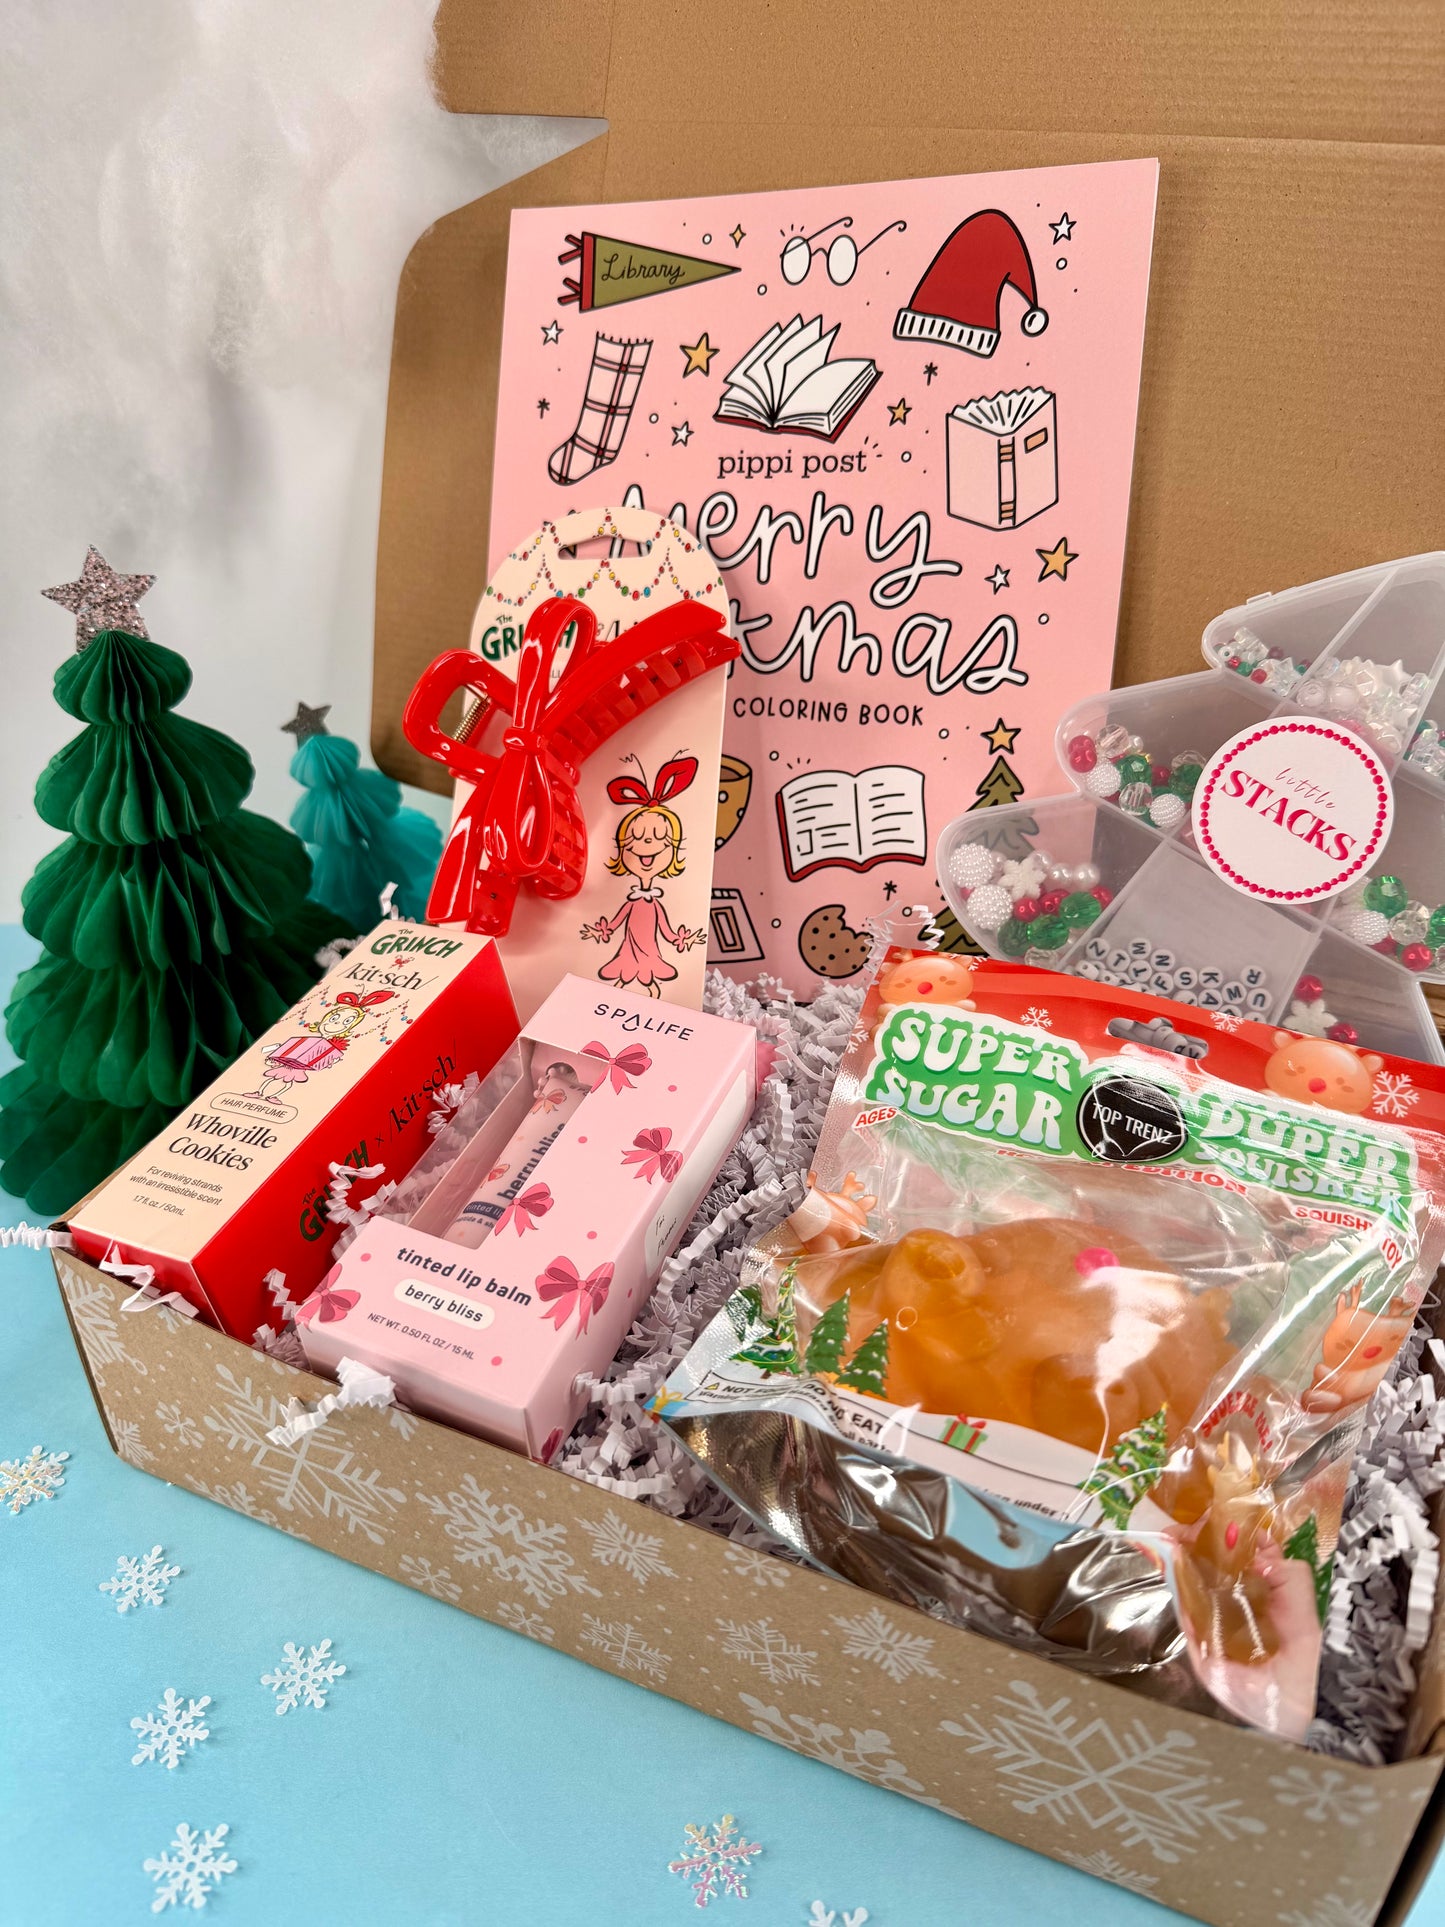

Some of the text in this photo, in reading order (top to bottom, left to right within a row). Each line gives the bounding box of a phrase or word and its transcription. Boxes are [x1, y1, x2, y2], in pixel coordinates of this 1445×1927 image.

[601, 253, 686, 285] Library
[717, 449, 867, 479] pippi post
[610, 484, 962, 609] erry
[733, 697, 924, 726] COLORING BOOK
[1275, 767, 1336, 809] little
[1220, 769, 1357, 861] STACKS
[370, 933, 464, 959] GRINCH
[594, 1003, 694, 1041] SPALIFE
[220, 1097, 288, 1119] HAIR PERFUME
[855, 1107, 897, 1127] AGES
[876, 1069, 1062, 1151] SUGAR
[892, 1016, 1399, 1190] SUPER DUPER
[185, 1112, 278, 1149] Whoville
[1092, 1102, 1175, 1146] TOP TRENZ
[168, 1136, 254, 1171] Cookies
[130, 1175, 223, 1206] with an irresistible scent
[147, 1165, 223, 1193] For reviving strands
[396, 1247, 533, 1307] tinted lip balm
[404, 1284, 484, 1323] berry bliss
[367, 1312, 387, 1325] NET
[385, 1318, 401, 1332] WT.
[401, 1325, 422, 1339] 0.50
[420, 1333, 432, 1344] FL
[432, 1337, 447, 1349] OZ
[452, 1344, 462, 1354] 15
[461, 1349, 475, 1361] ML
[722, 1385, 754, 1394] NOT
[851, 1412, 884, 1435] EAT
